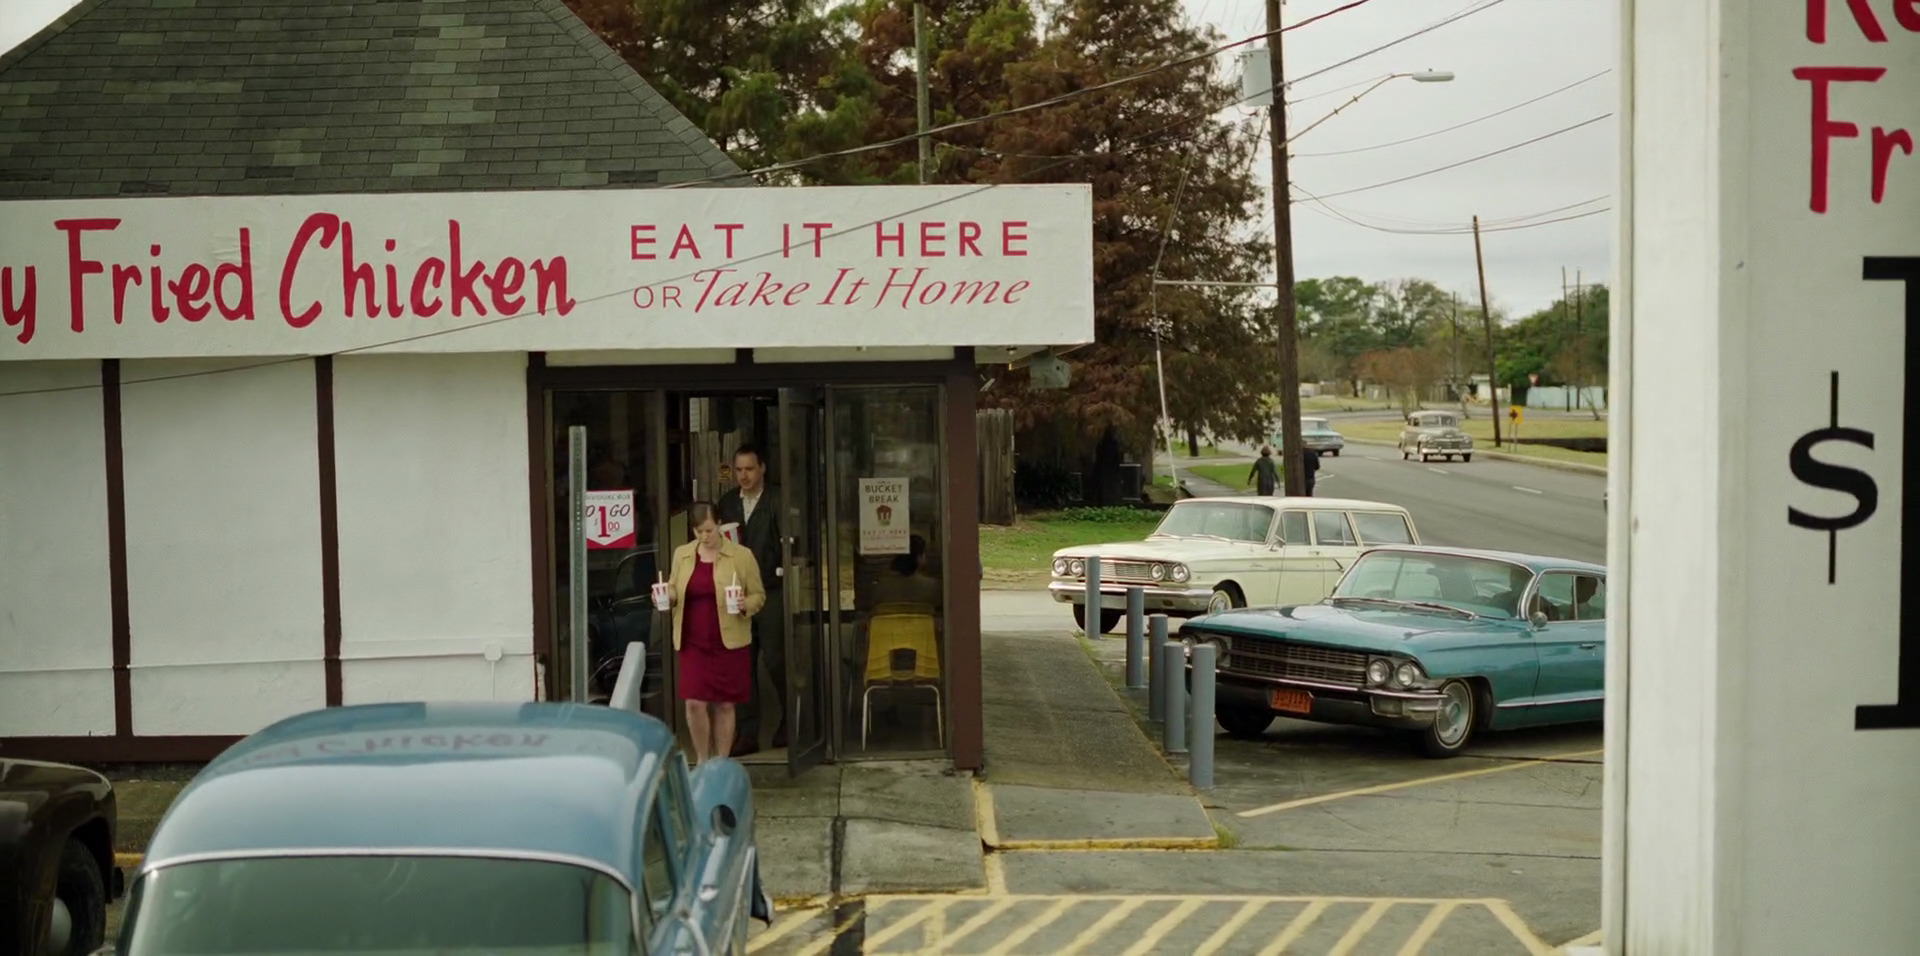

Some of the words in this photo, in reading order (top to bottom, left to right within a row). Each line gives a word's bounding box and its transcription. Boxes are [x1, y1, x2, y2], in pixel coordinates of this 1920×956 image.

[1792, 66, 1914, 214] Fr
[630, 223, 745, 260] EAT
[783, 222, 833, 258] IT
[875, 219, 1029, 257] HERE
[54, 217, 256, 333] Fried
[279, 212, 577, 328] Chicken
[633, 285, 682, 309] OR
[694, 268, 811, 313] Take
[817, 267, 870, 306] It
[873, 266, 1032, 309] Home
[864, 484, 903, 494] BUCKET
[868, 495, 900, 504] BREAK
[609, 503, 631, 517] GO
